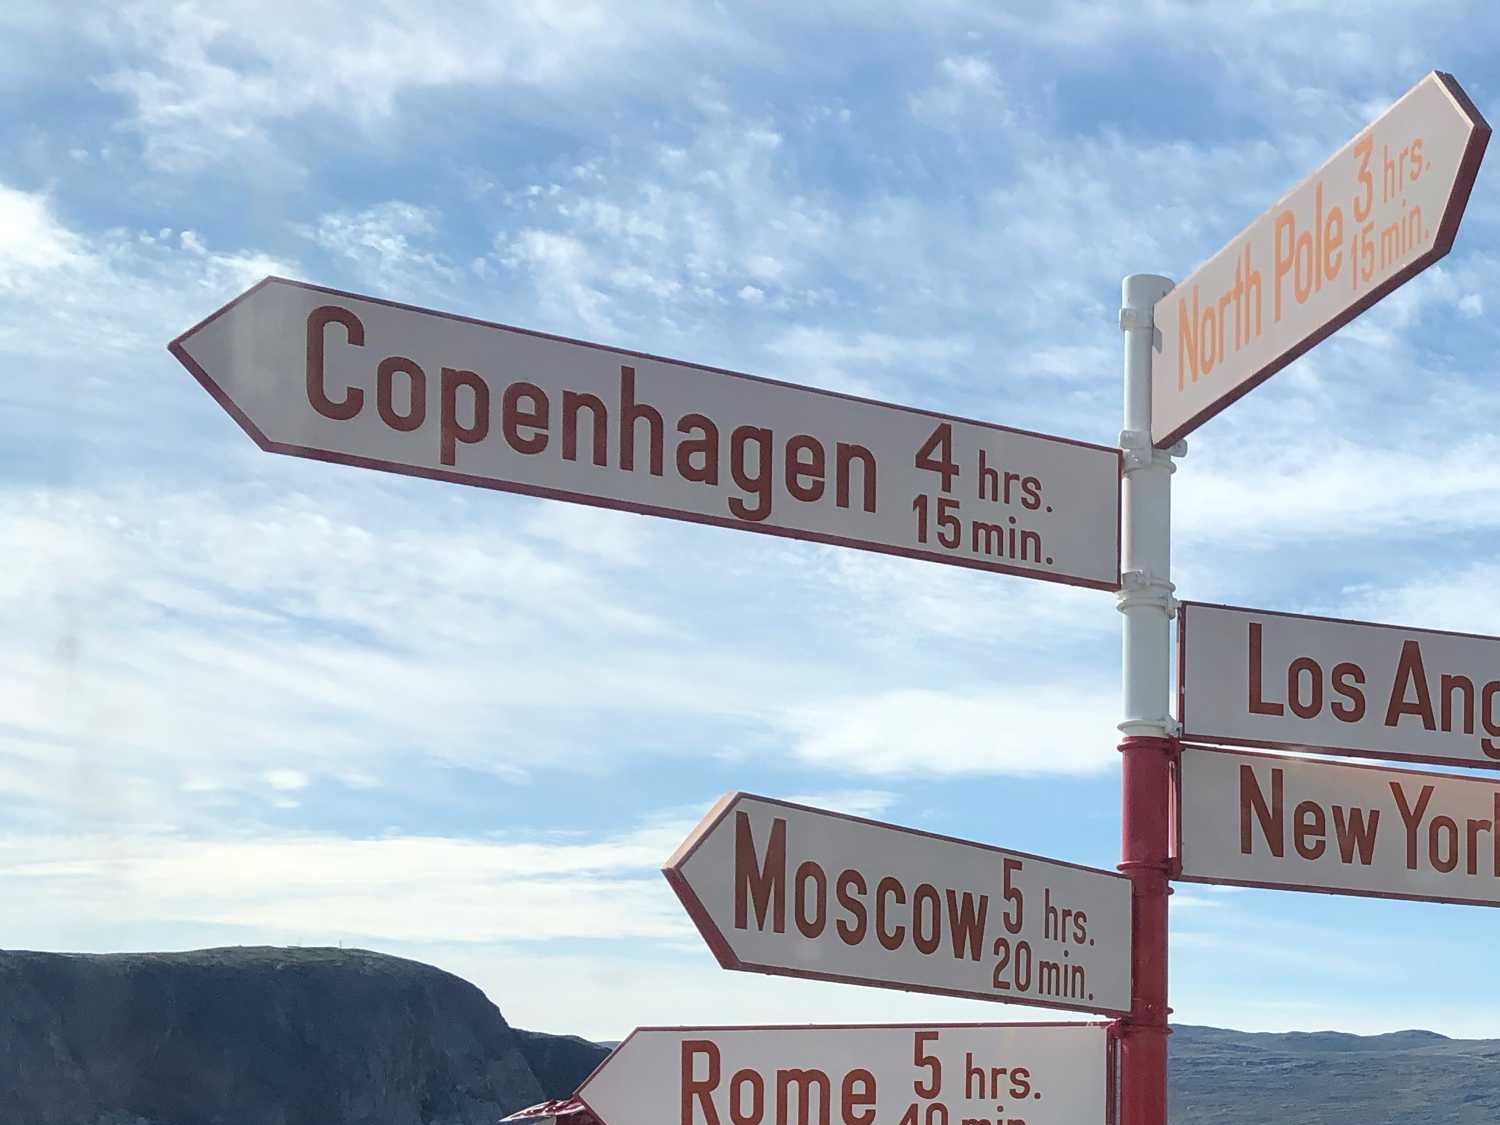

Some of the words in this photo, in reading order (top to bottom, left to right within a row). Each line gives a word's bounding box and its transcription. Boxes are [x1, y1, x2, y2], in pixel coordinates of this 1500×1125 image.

[1177, 246, 1262, 392] North
[1274, 182, 1344, 322] Pole
[1353, 132, 1375, 224] 3
[1382, 137, 1431, 204] hrs.
[1351, 223, 1374, 290] 15
[1380, 199, 1430, 270] min.
[305, 304, 878, 523] Copenhagen
[914, 422, 961, 495] 4
[976, 449, 1055, 514] hrs.
[911, 494, 962, 550] 15
[971, 506, 1055, 567] min.
[1248, 622, 1366, 724] Los
[1239, 764, 1381, 867] New
[733, 810, 989, 962] Moscow
[1003, 857, 1024, 935] 5
[1044, 887, 1096, 947] hrs.
[991, 937, 1032, 991] 20
[1038, 949, 1095, 1002] min.
[913, 1031, 943, 1100] 5
[964, 1052, 1043, 1101] hrs.
